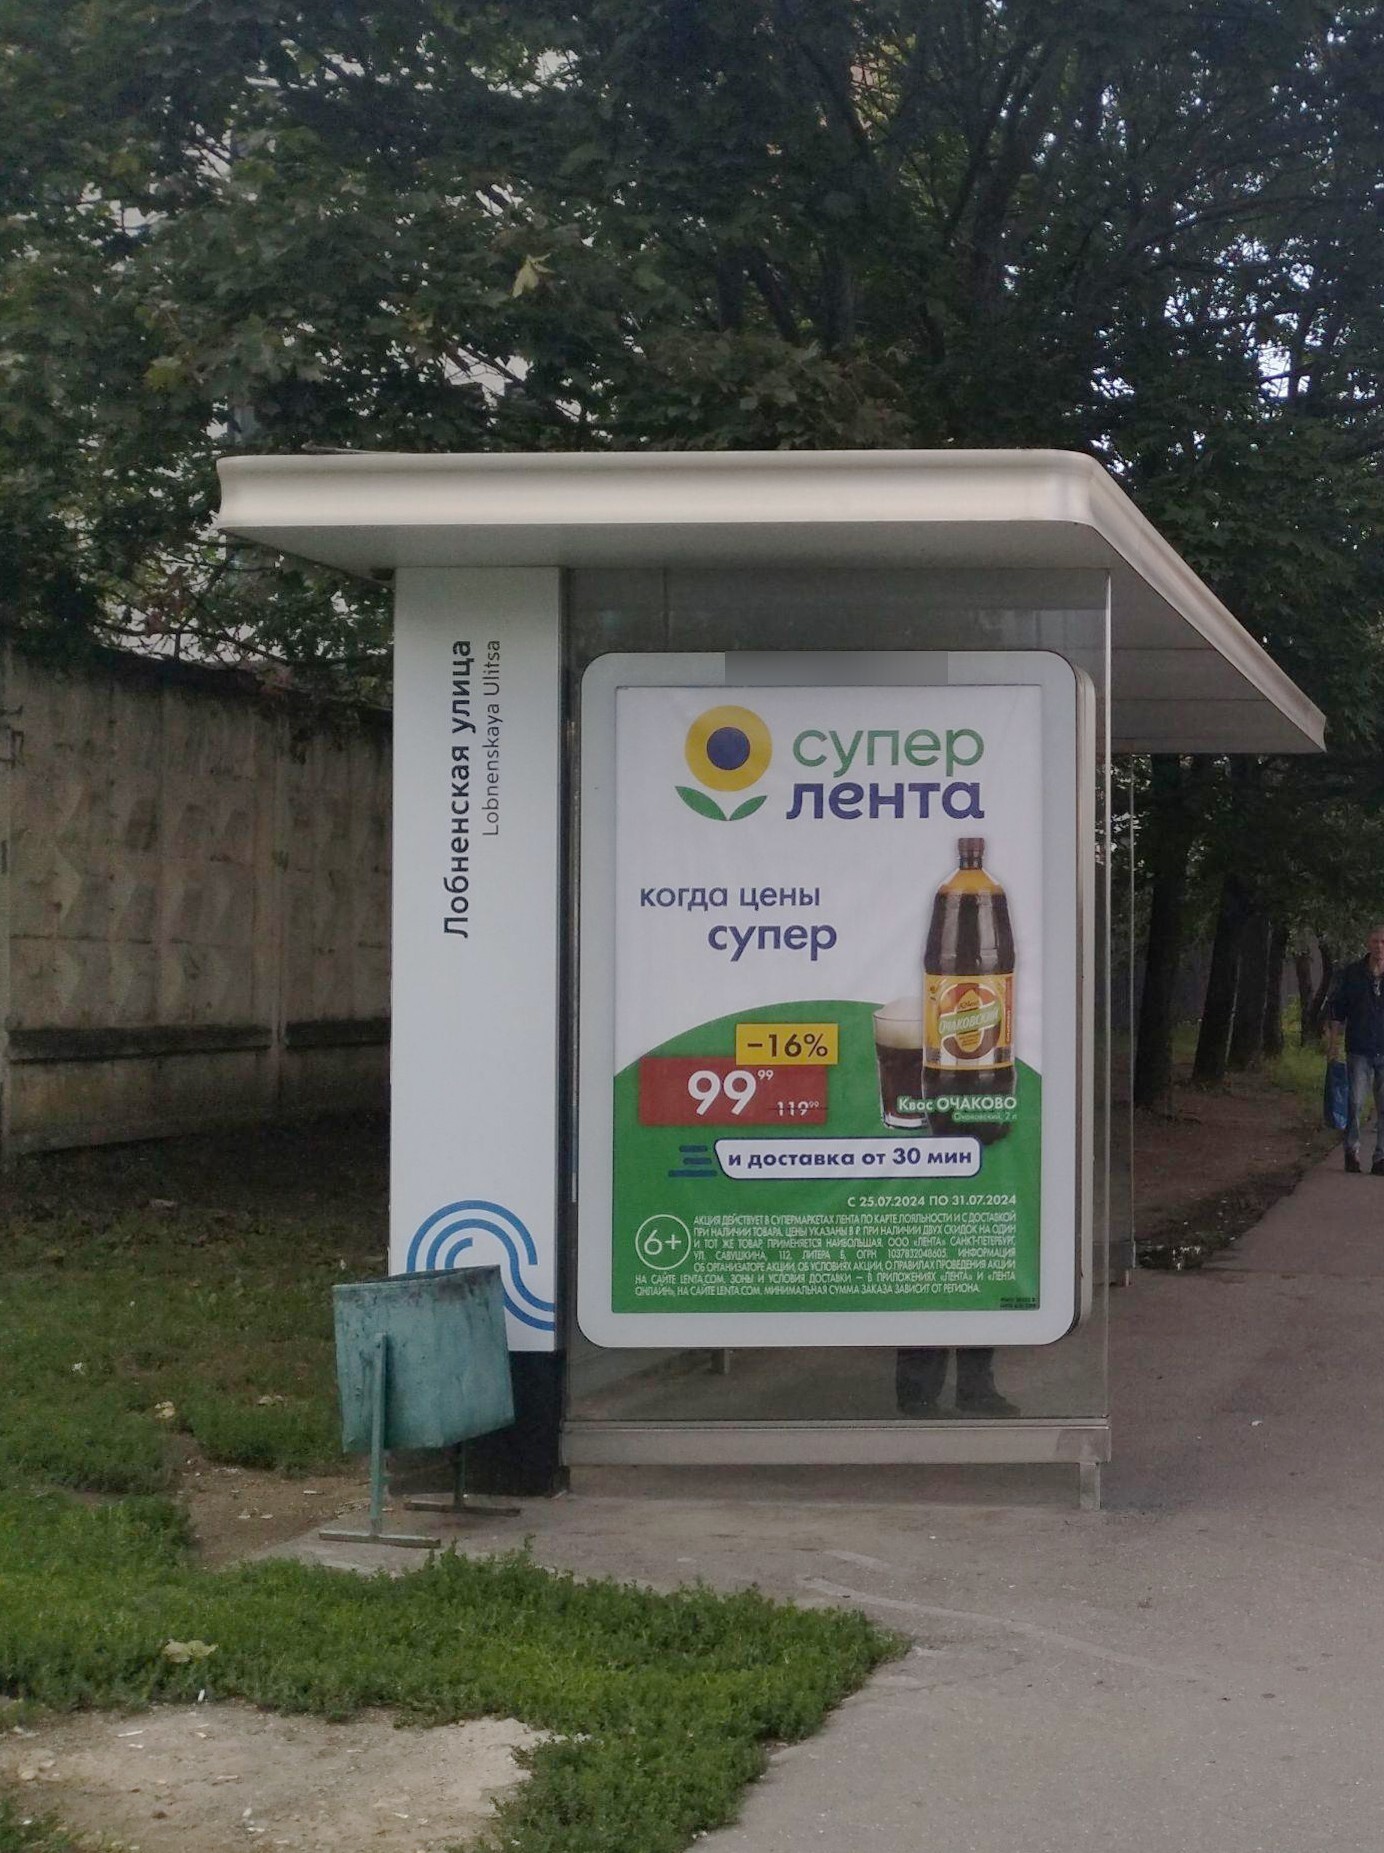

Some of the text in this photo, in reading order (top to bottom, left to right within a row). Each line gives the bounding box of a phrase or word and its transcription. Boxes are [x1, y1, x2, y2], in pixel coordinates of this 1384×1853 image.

[482, 640, 503, 836] Lobnenskaya Ulitsa
[792, 727, 985, 778] супер
[444, 640, 476, 938] Лобненская улица
[785, 781, 986, 821] лента
[641, 887, 820, 911] когда цены
[707, 924, 837, 962] супер
[688, 1070, 757, 1115] 99
[899, 1097, 1017, 1111] Квас ОЧАКОВО
[728, 1148, 972, 1169] и доставка от 30 мин
[847, 1194, 1016, 1207] С 25.07.2024 ПО 31.07.2024
[694, 1215, 720, 1226] АКЦИЯ
[771, 1214, 834, 1225] СУПЕРМАРКЕТАХ
[835, 1214, 860, 1224] ЛЕНТА
[861, 1214, 873, 1223] ПО
[874, 1213, 897, 1223] КАРТЕ
[898, 1213, 952, 1223] ЛОЯЛЬНОСТИ
[694, 1227, 708, 1237] ПРИ
[863, 1226, 879, 1235] ПРИ
[944, 1225, 977, 1235] СКИДОК
[979, 1225, 990, 1234] НА
[992, 1225, 1016, 1235] ОДИН
[643, 1229, 682, 1255] 6+
[704, 1239, 718, 1248] ТОТ
[723, 1239, 734, 1248] ЖЕ
[888, 1237, 909, 1247] ООО
[856, 1249, 877, 1259] ОГРН
[635, 1275, 647, 1284] НА
[730, 1274, 753, 1284] ЗОНЫ
[809, 1273, 851, 1284] ДОСТАВКИ
[677, 1287, 689, 1296] НА
[829, 1285, 860, 1295] СУММА
[861, 1284, 893, 1295] ЗАКАЗА
[895, 1284, 930, 1294] ЗАВИСИТ
[931, 1284, 942, 1293] ОТ
